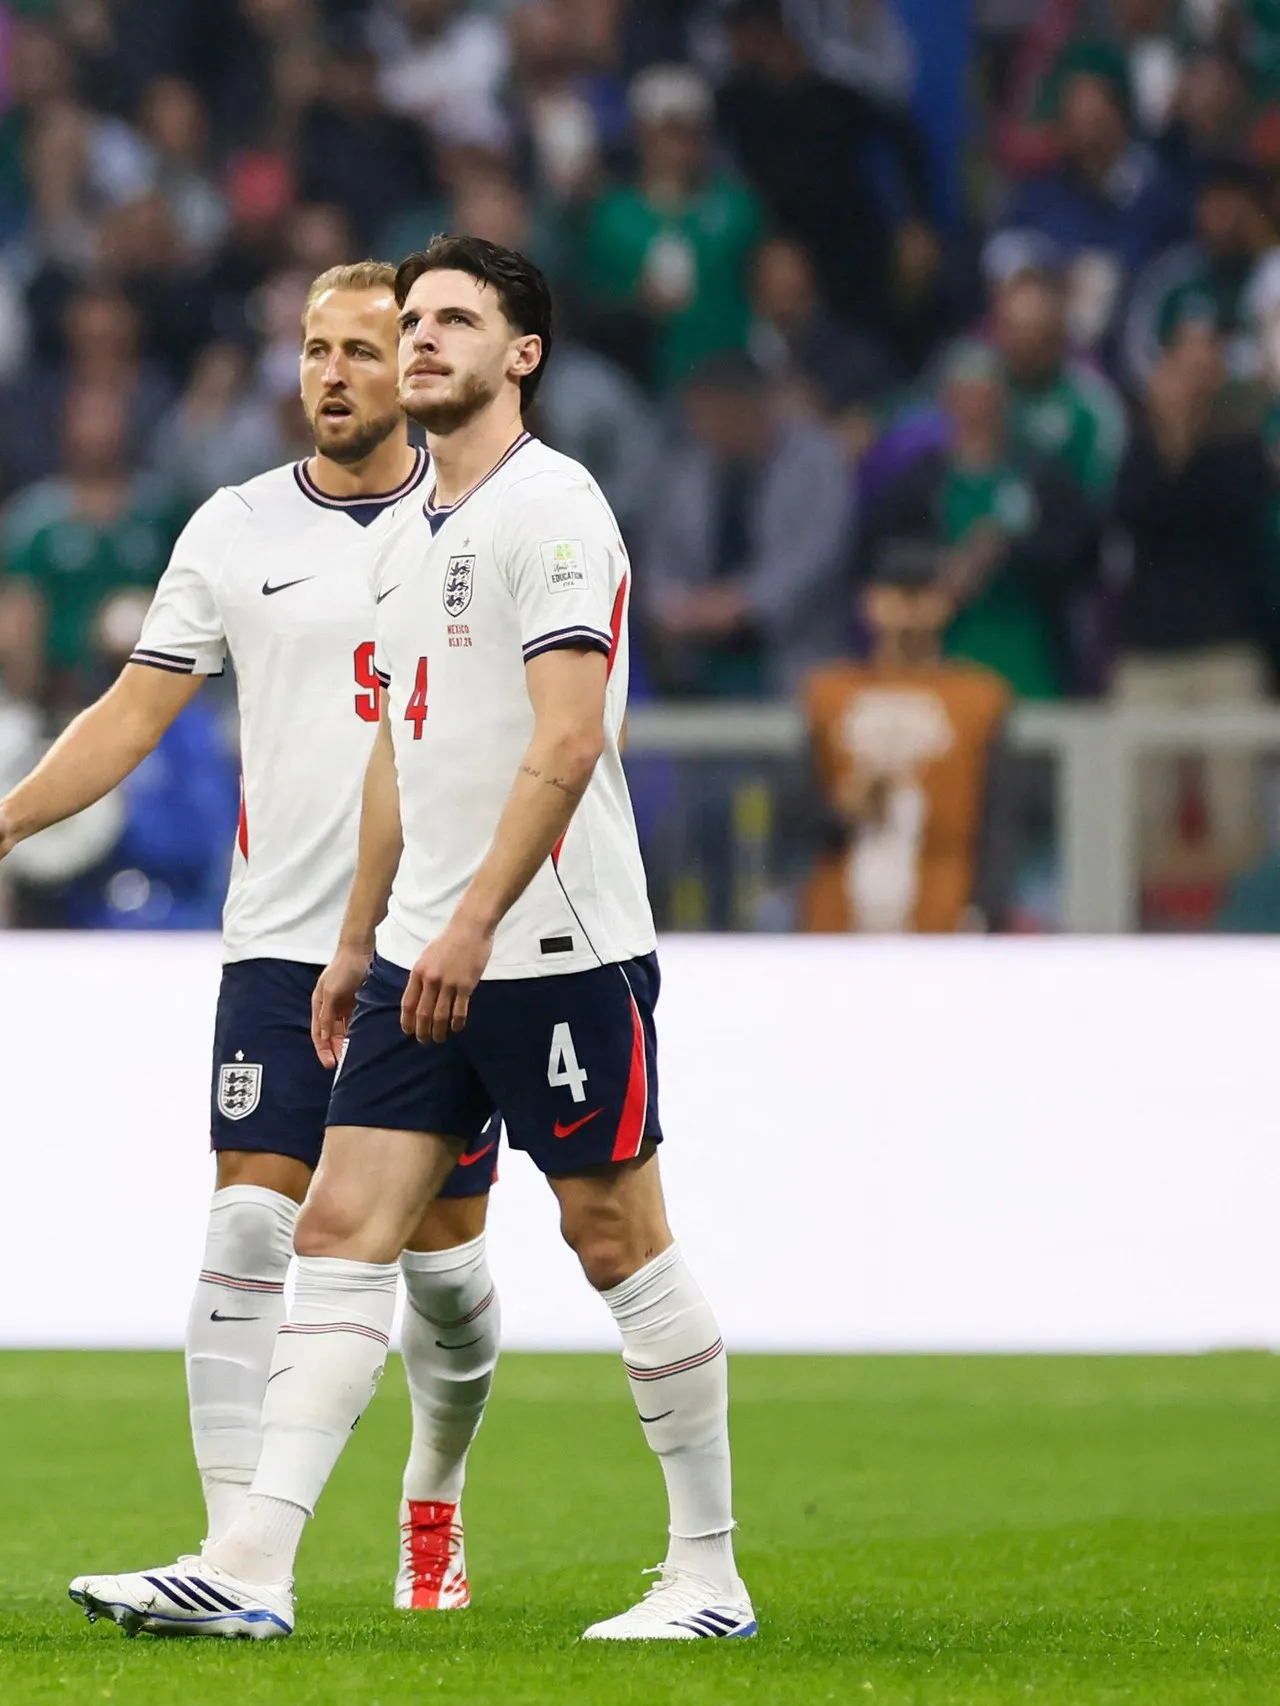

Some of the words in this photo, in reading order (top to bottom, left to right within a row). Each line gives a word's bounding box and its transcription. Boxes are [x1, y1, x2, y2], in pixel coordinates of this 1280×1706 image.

[551, 571, 584, 583] EDUCATION
[447, 624, 470, 634] MEXICO
[353, 641, 380, 722] 9
[404, 656, 428, 740] 4
[547, 1022, 588, 1103] 4
